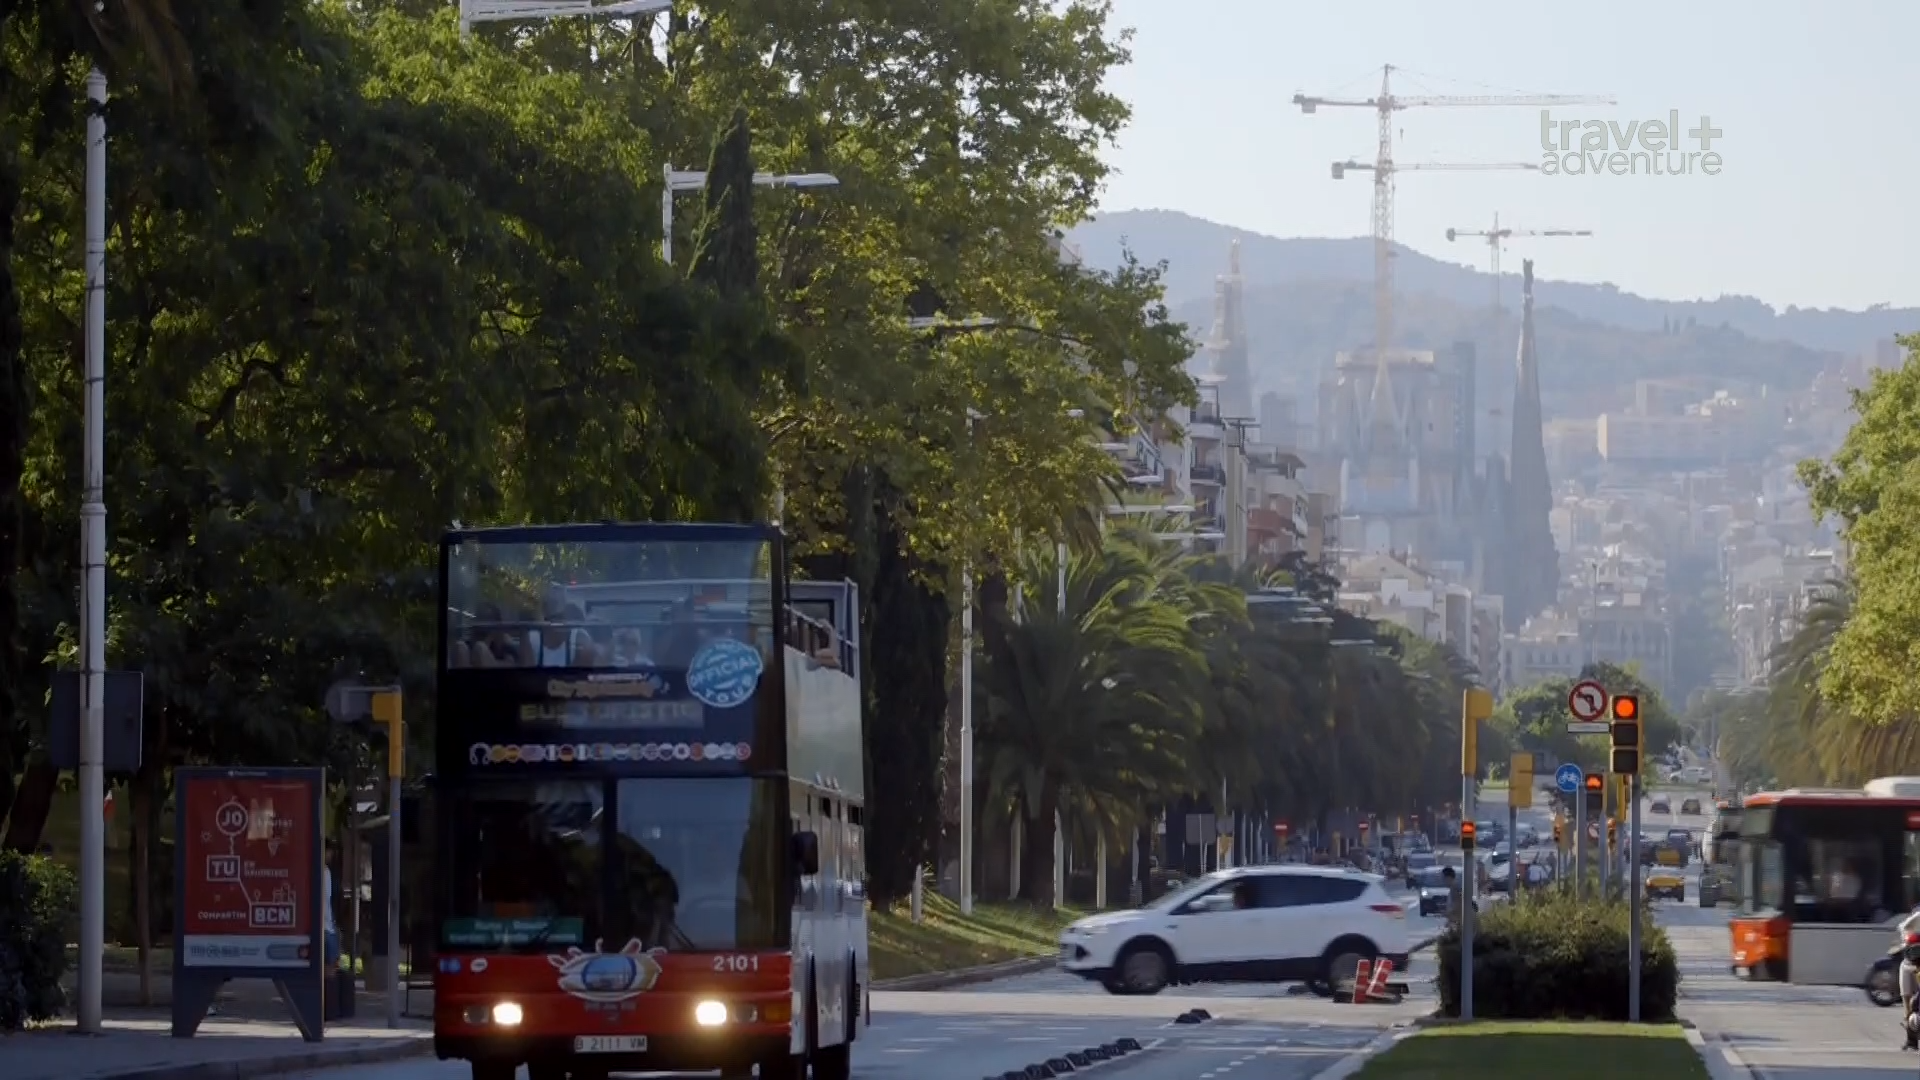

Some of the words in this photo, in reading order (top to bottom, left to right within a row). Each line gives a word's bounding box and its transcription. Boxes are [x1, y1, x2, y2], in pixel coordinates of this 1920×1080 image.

[211, 861, 235, 876] TU
[254, 907, 291, 923] BCN
[713, 955, 759, 972] 2101
[590, 1037, 621, 1050] 2111
